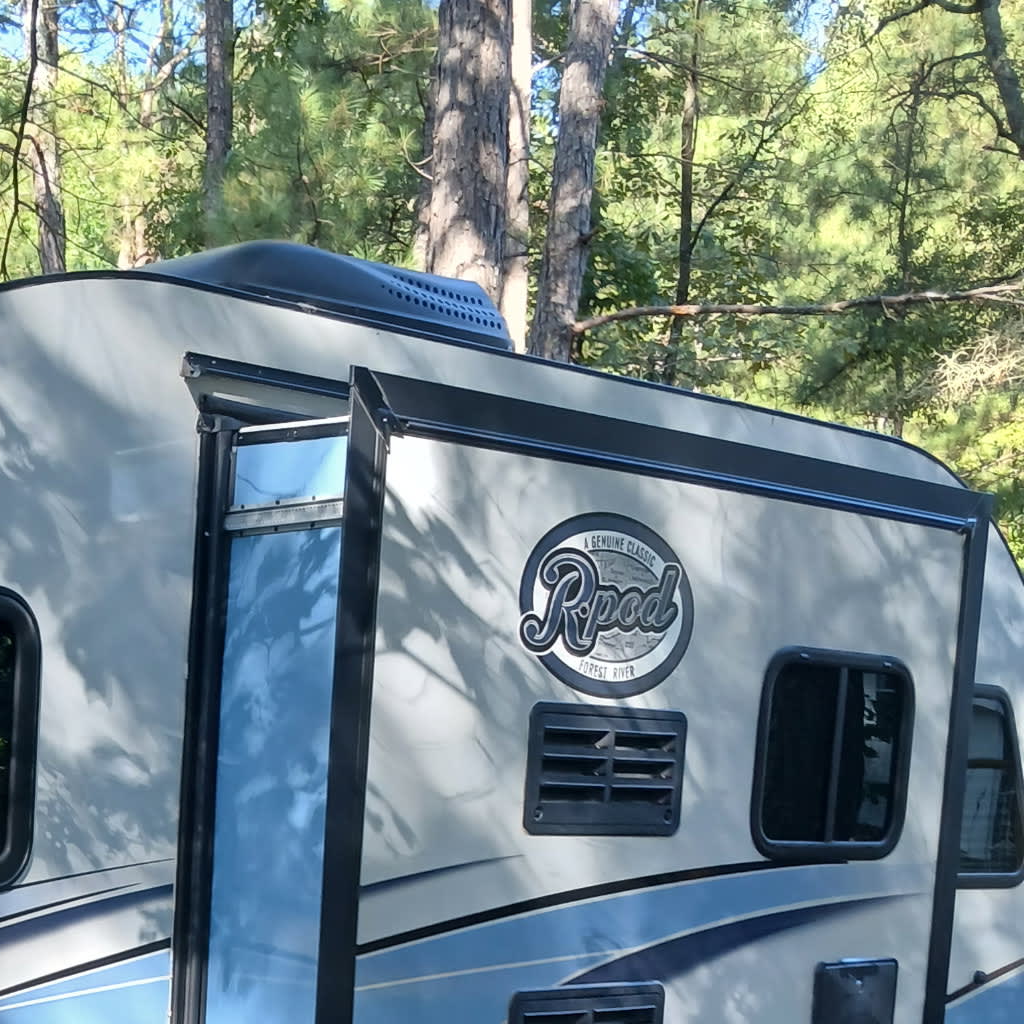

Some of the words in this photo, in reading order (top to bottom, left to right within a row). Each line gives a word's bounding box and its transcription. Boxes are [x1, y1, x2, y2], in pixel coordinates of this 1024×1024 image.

[584, 538, 589, 550] A
[592, 535, 625, 551] GENUINE
[626, 541, 657, 568] CLASSIC
[578, 661, 607, 679] FOREST
[613, 665, 636, 680] RIVER
